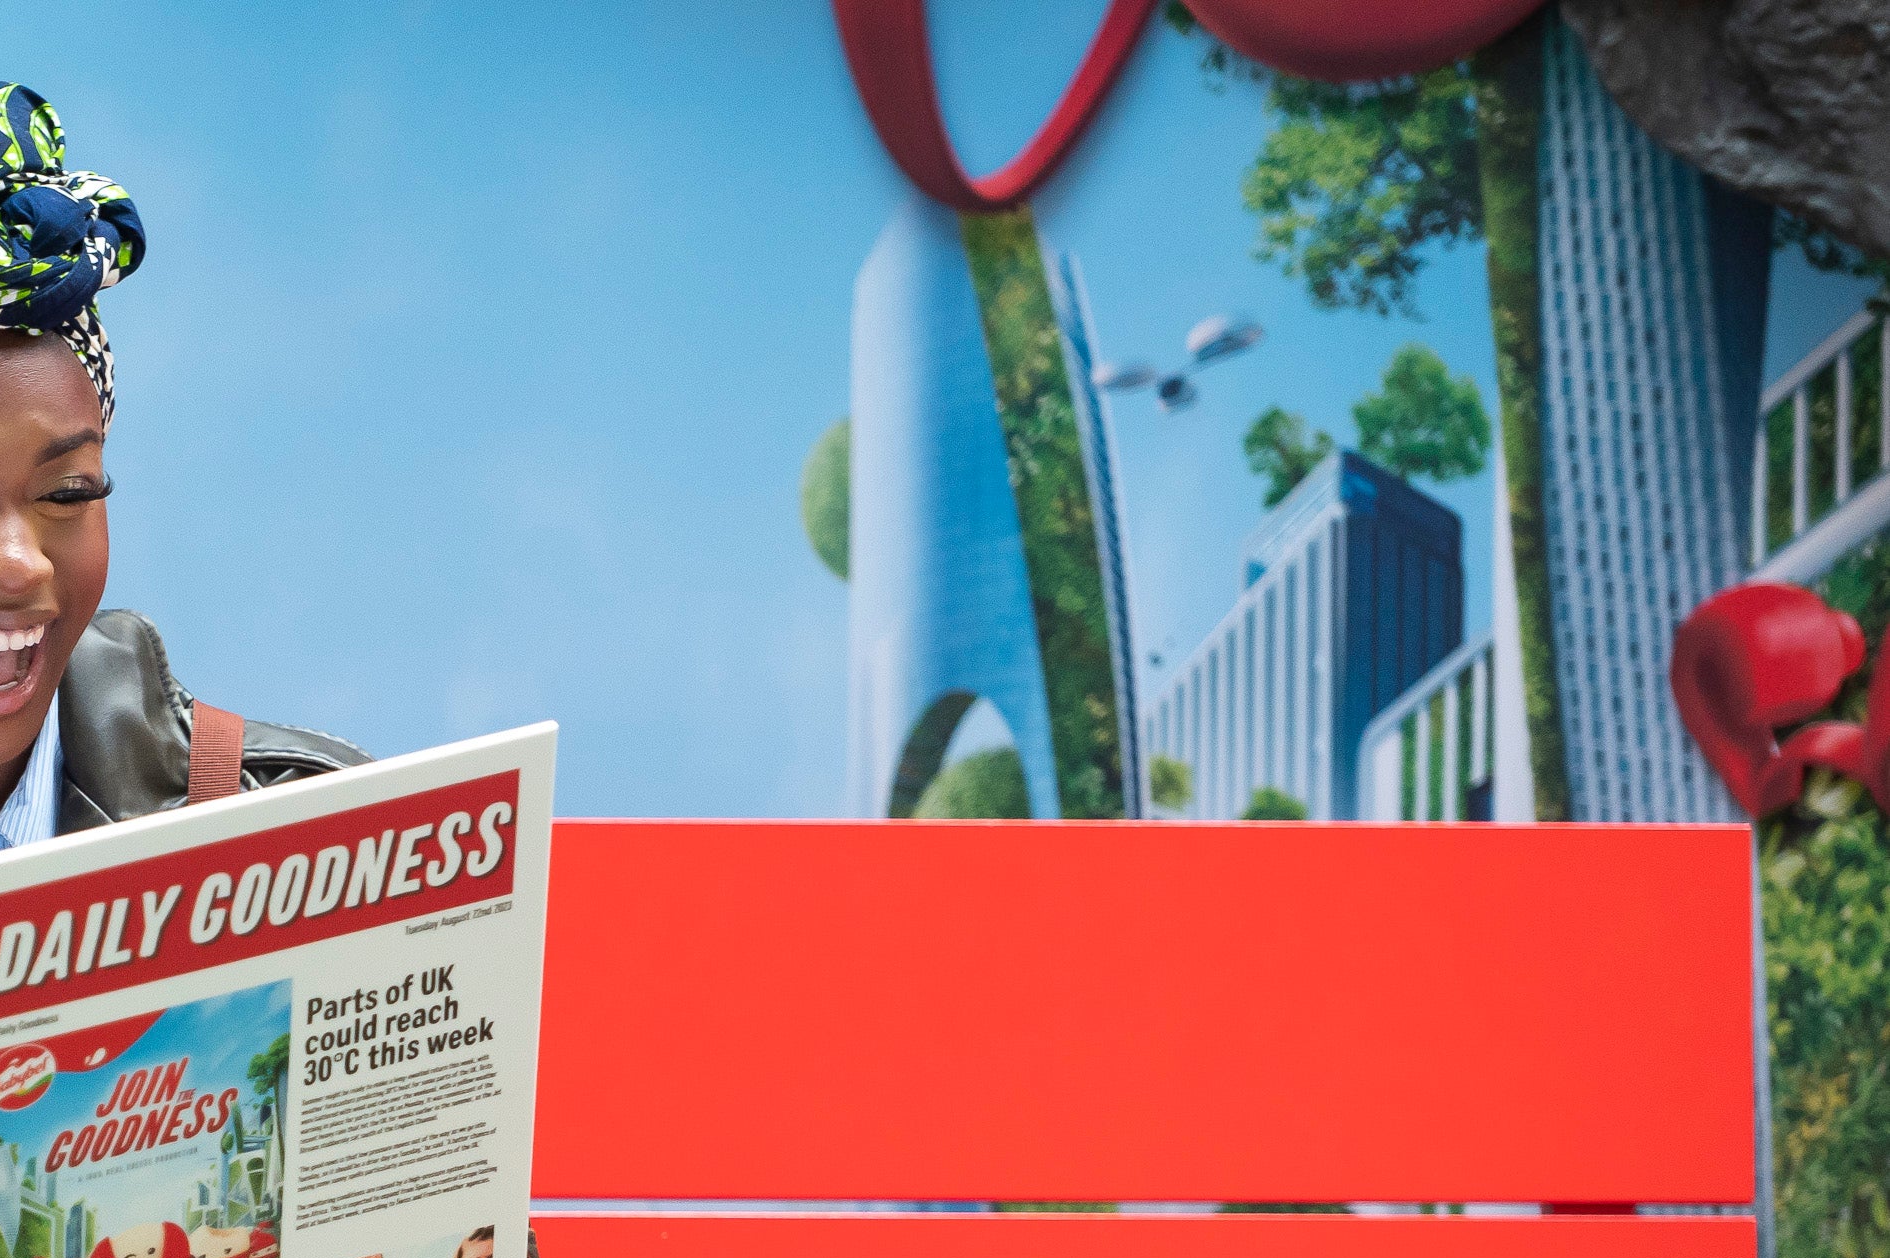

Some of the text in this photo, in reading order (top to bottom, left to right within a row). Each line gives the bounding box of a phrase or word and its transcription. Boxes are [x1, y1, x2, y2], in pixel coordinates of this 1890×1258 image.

[190, 801, 514, 945] GOODNESS
[405, 921, 438, 934] Tuesday
[439, 911, 470, 926] August
[17, 1014, 58, 1030] Goodness
[306, 964, 454, 1024] Parts of UK
[303, 1016, 493, 1085] 30°C this week
[304, 995, 458, 1055] could reach
[96, 1057, 189, 1118] JOIN
[45, 1088, 238, 1173] GOODNESS
